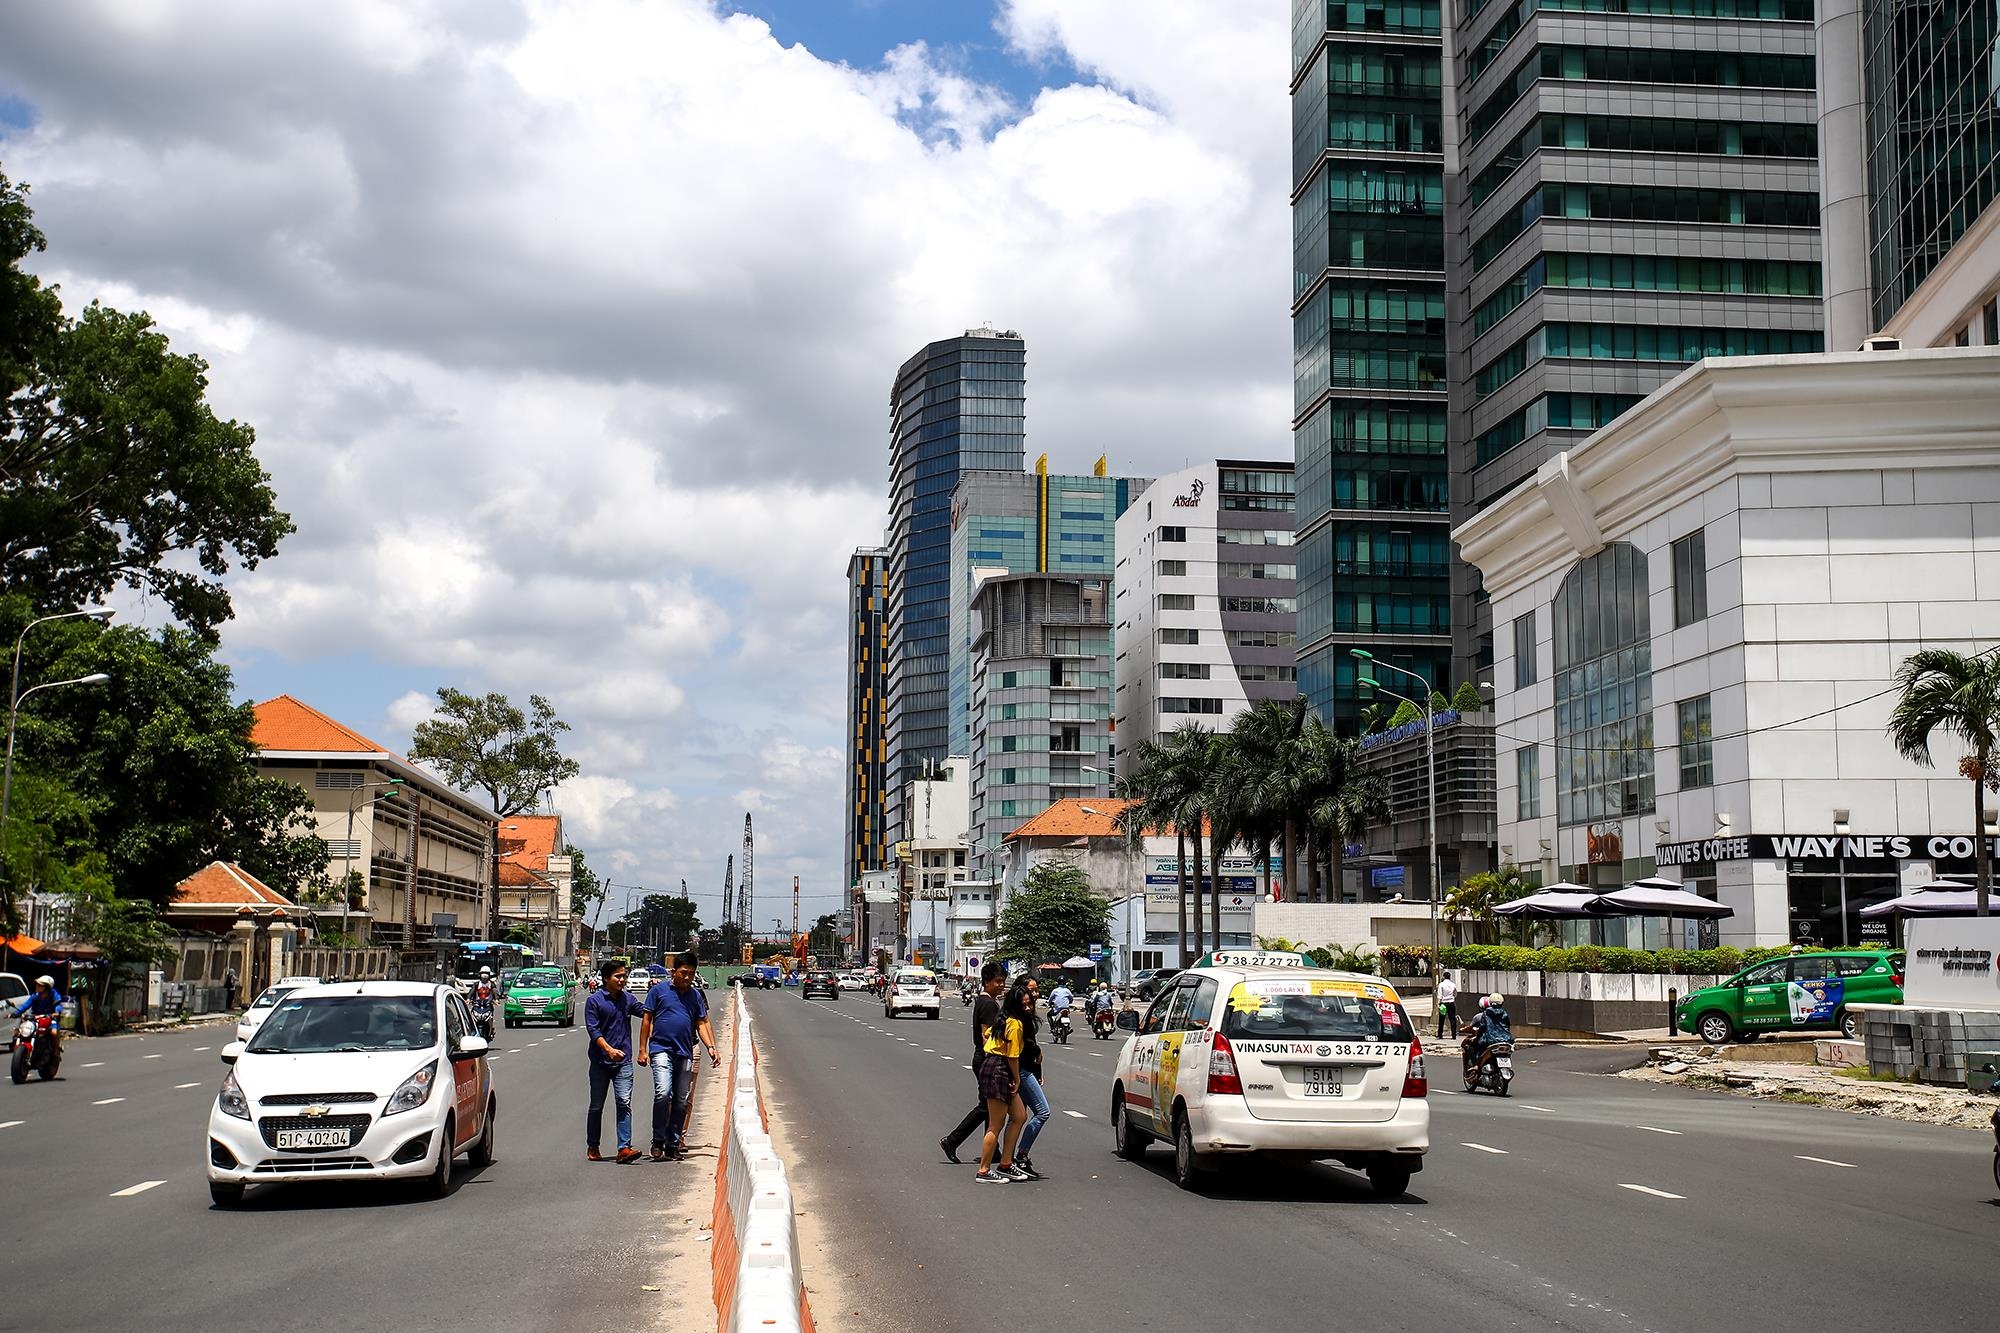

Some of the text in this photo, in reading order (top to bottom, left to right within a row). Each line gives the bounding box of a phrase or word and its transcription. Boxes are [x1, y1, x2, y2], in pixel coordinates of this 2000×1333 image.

[1655, 838, 1748, 866] WAYNE'S COFFEE
[1771, 836, 1912, 858] WAYNE'S
[1221, 860, 1254, 868] GSP
[1232, 956, 1300, 967] 38.27 27 27
[1335, 1045, 1371, 1055] 38.27
[1375, 1045, 1389, 1056] 27
[1393, 1045, 1407, 1056] 27
[1312, 1069, 1333, 1081] 51A
[1305, 1082, 1342, 1094] 791.89
